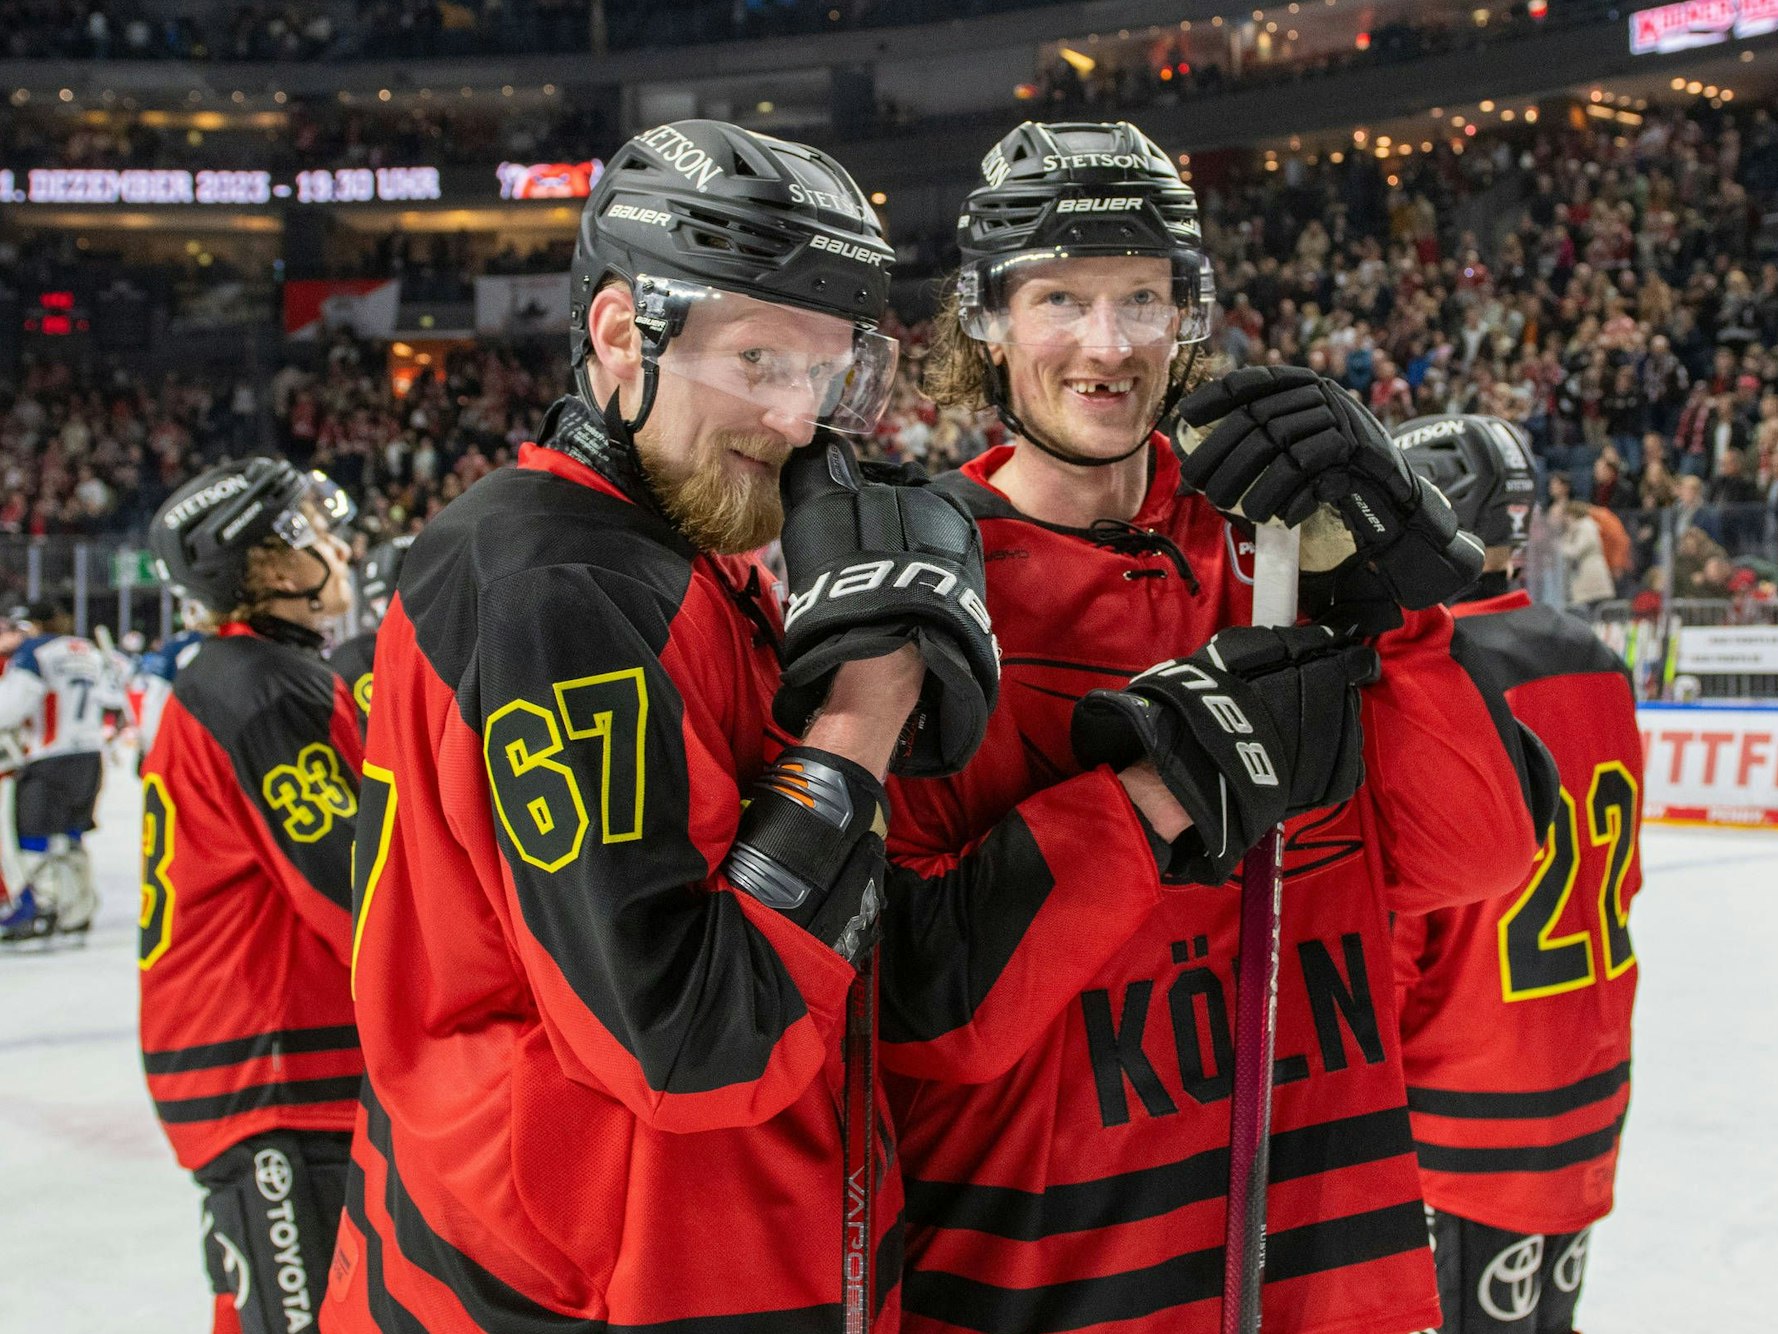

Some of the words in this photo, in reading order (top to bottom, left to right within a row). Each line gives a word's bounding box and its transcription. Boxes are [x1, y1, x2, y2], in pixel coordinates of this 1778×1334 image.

[1043, 153, 1150, 172] STETSON
[607, 204, 672, 227] BAUER
[1056, 197, 1144, 214] BAUER
[809, 234, 882, 267] BAUER
[164, 474, 249, 530] STETSON
[69, 678, 95, 720] 7
[262, 741, 359, 843] 33
[484, 666, 649, 874] 67
[1498, 760, 1638, 1003] 22
[267, 1200, 313, 1334] TOYOTA
